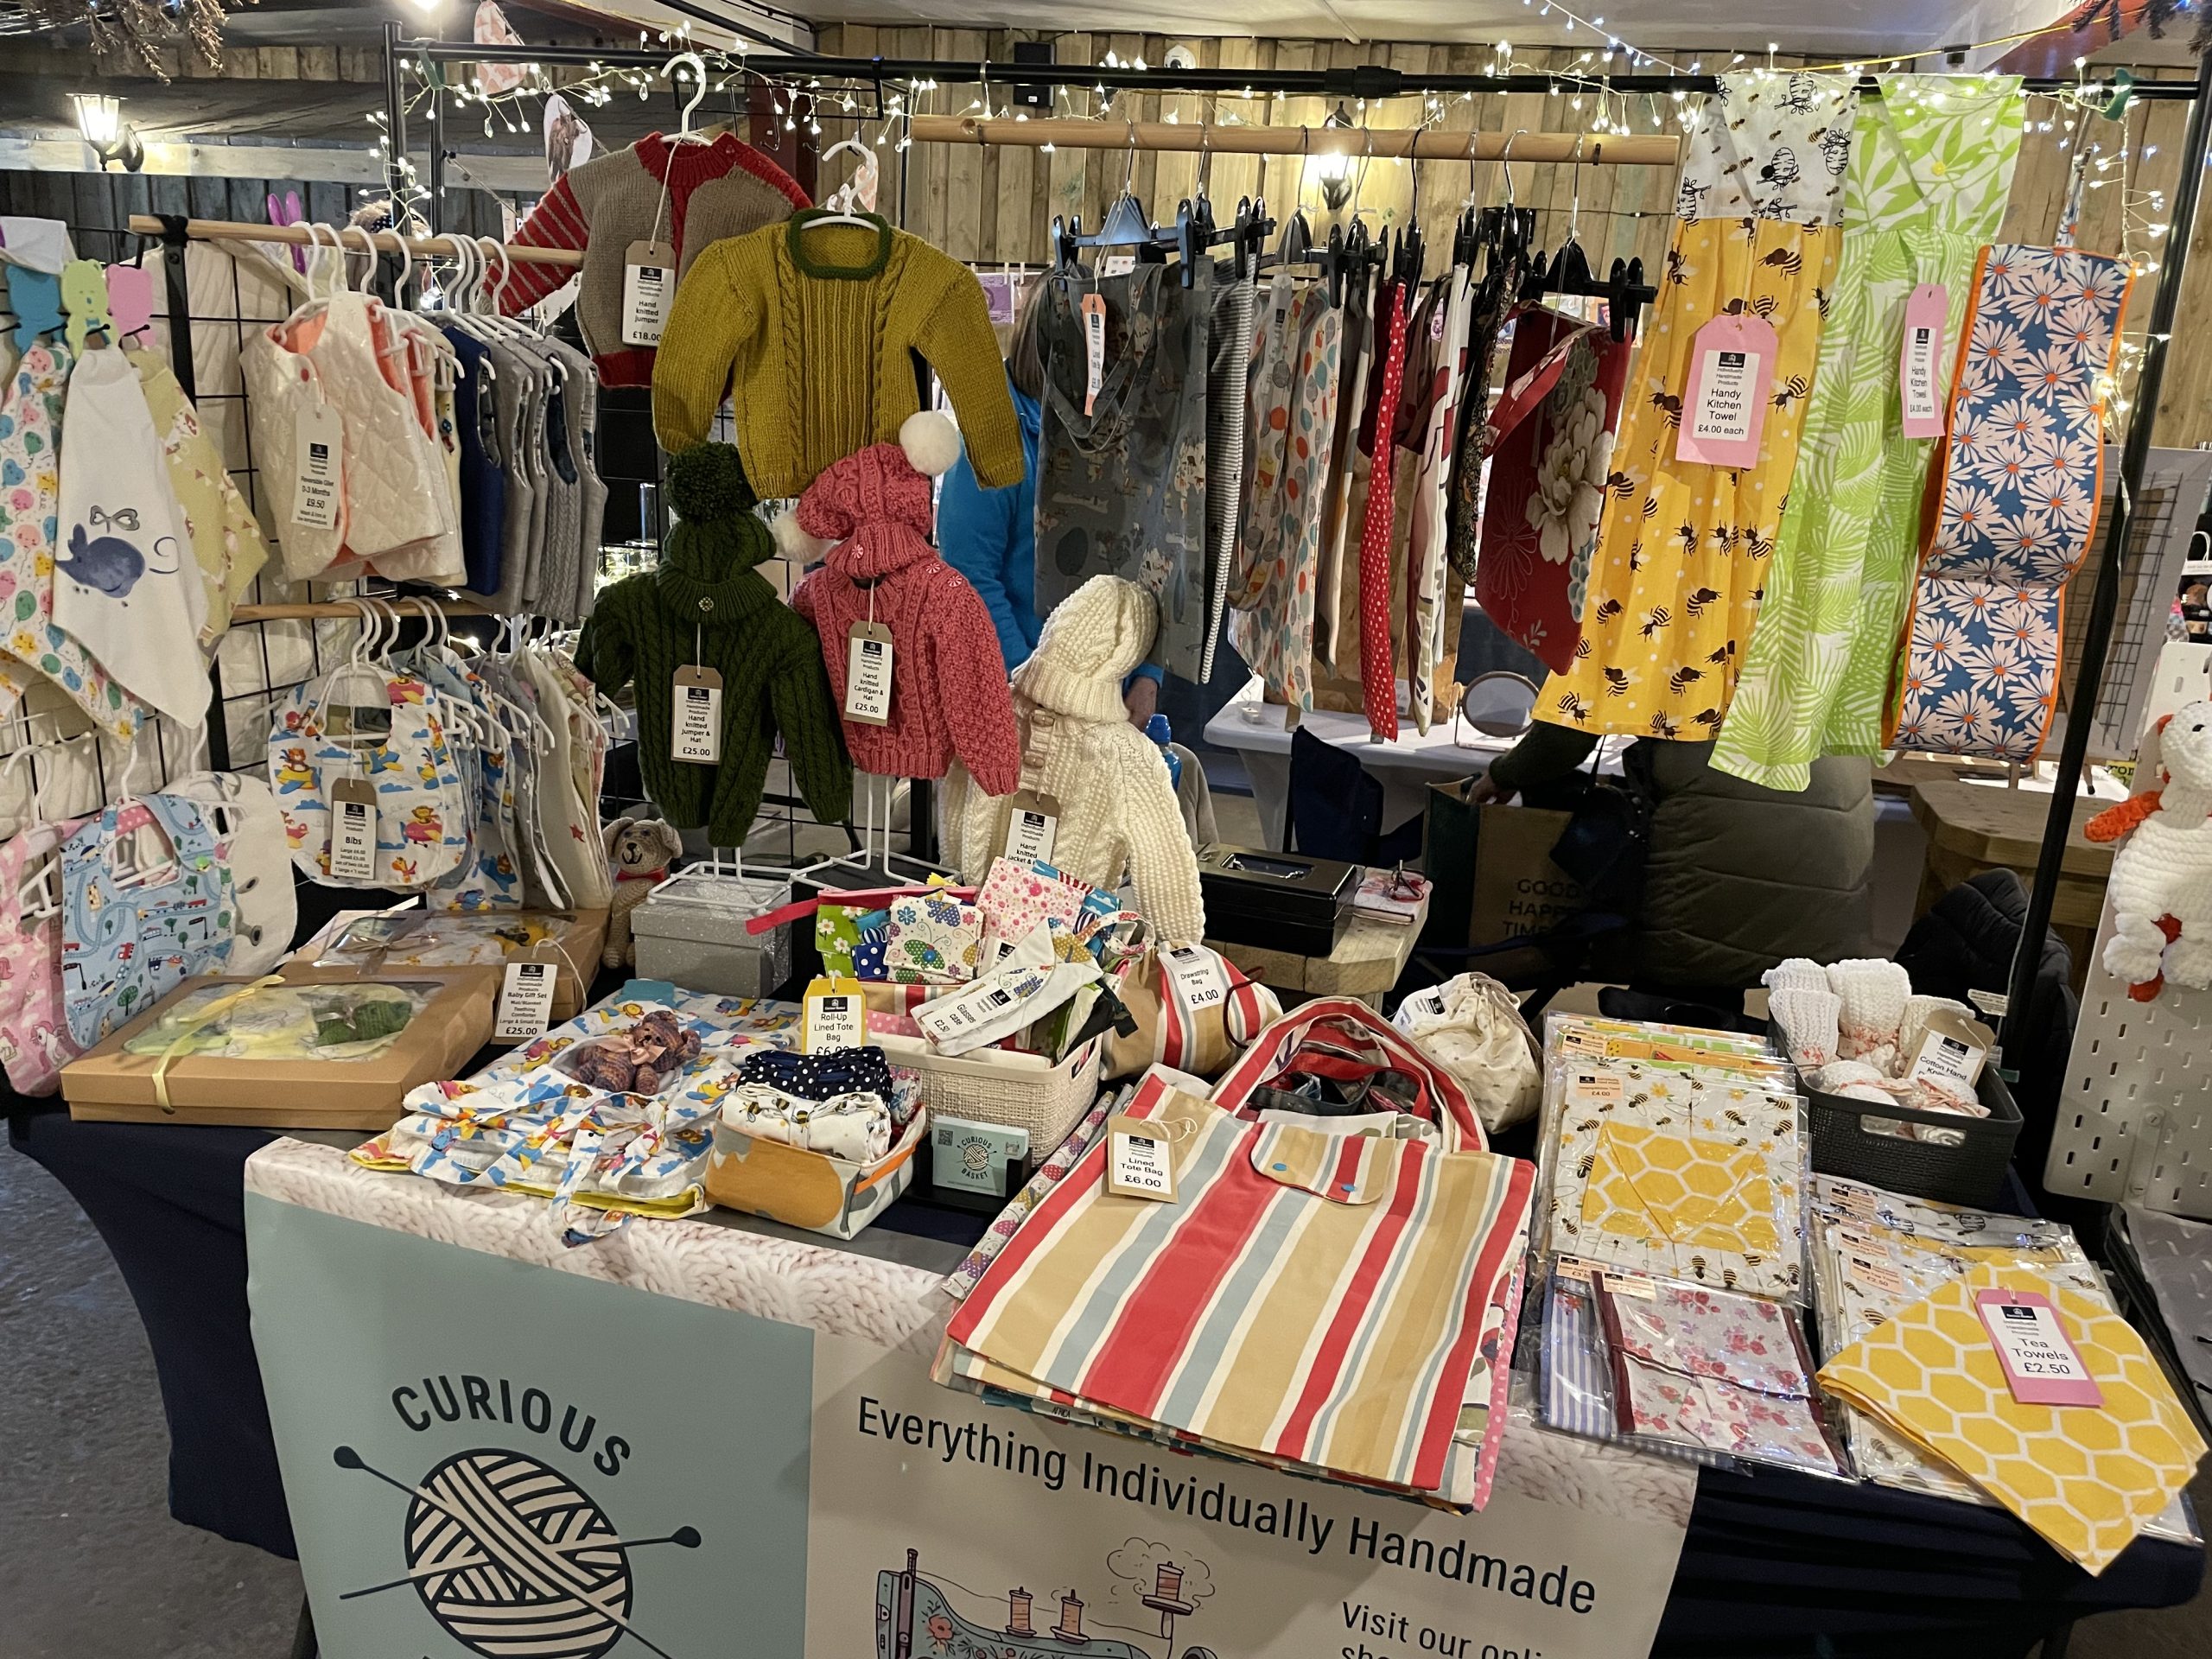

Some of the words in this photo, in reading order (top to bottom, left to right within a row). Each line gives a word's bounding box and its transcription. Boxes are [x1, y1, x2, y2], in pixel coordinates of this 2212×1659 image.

[636, 308, 658, 316] knitted
[1912, 366, 1926, 378] Handy
[1712, 388, 1741, 400] Handy
[1912, 390, 1926, 398] Towel
[1707, 399, 1741, 410] Kitchen
[1709, 411, 1737, 421] Towel
[1698, 424, 1721, 433] £4.00
[307, 499, 325, 509] £9.50
[855, 685, 878, 695] Cardigan
[855, 702, 879, 713] £25.00
[683, 747, 710, 756] £25.00
[346, 836, 362, 845] Bibs
[1016, 849, 1037, 858] knitted
[1517, 879, 1579, 899] GOOD
[1180, 969, 1209, 980] Drawstring
[1192, 989, 1218, 1004] £4.00
[957, 1004, 976, 1023] Glasses
[935, 1020, 950, 1032] £2.50
[827, 1033, 841, 1042] Bag
[1920, 1056, 1944, 1071] Cotton
[1946, 1067, 1967, 1080] Hand
[962, 1136, 992, 1149] CURIOUS
[1128, 1158, 1154, 1166] Lined
[962, 1168, 988, 1179] BASKET
[1145, 1166, 1163, 1176] Bag
[1124, 1175, 1161, 1187] £6.00
[2018, 1338, 2048, 1348] Tea
[2012, 1348, 2069, 1360] Towels
[2024, 1362, 2070, 1374] £2.50
[1052, 1406, 1071, 1418] AFRICA
[391, 1375, 631, 1476] CURIOUS
[859, 1395, 1067, 1491] Everything
[1083, 1452, 1334, 1555] Individually
[1349, 1516, 1596, 1614] Handmade
[1343, 1601, 1409, 1643] Visit
[1419, 1628, 1471, 1659] our
